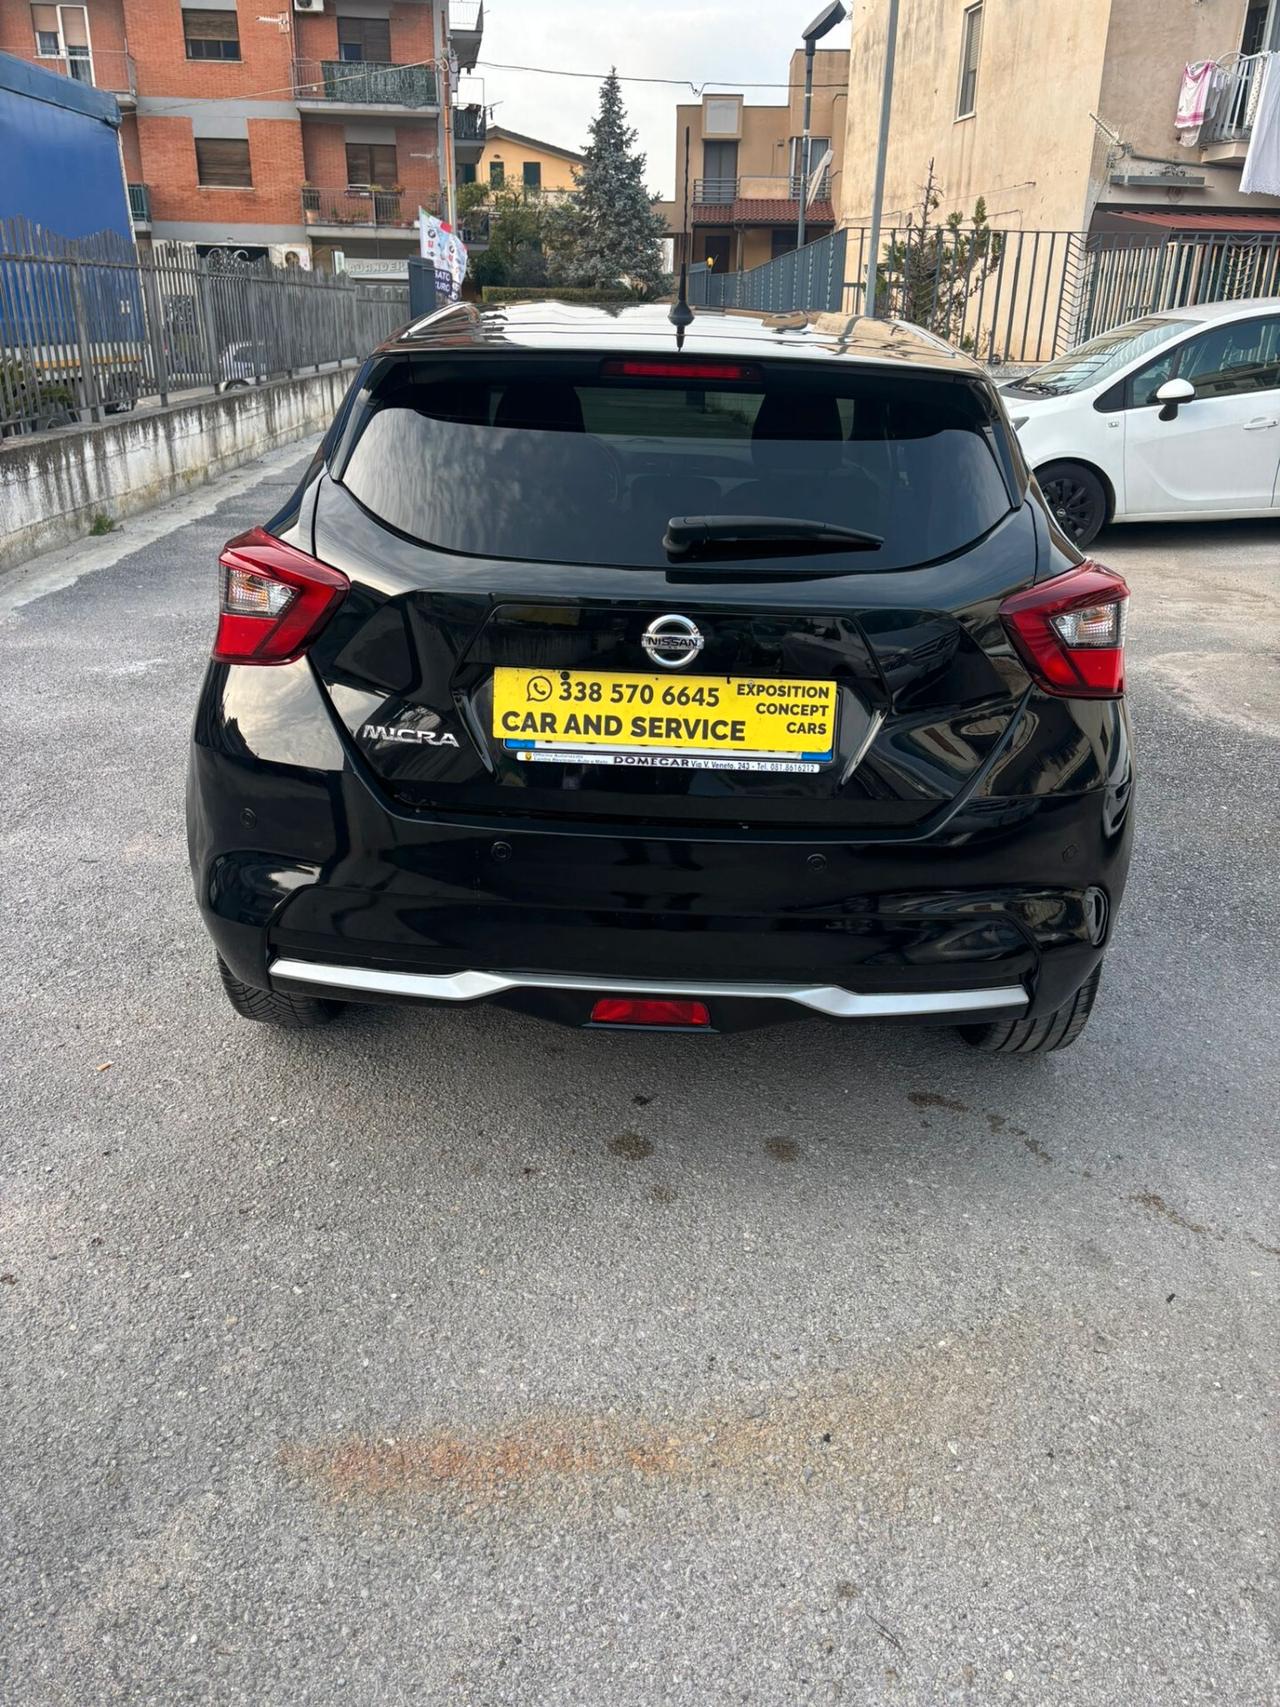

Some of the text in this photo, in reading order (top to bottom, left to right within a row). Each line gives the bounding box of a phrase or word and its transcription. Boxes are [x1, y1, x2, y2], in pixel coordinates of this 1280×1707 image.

[648, 636, 698, 647] NISSAN
[559, 681, 720, 707] 338 570 6645
[736, 683, 830, 699] EXPOSITION
[755, 703, 829, 717] CONCEPT
[501, 711, 746, 741] CAR AND SERVICE
[786, 722, 827, 735] CARS
[362, 724, 460, 748] MICRA
[613, 756, 689, 767] DOMECAR
